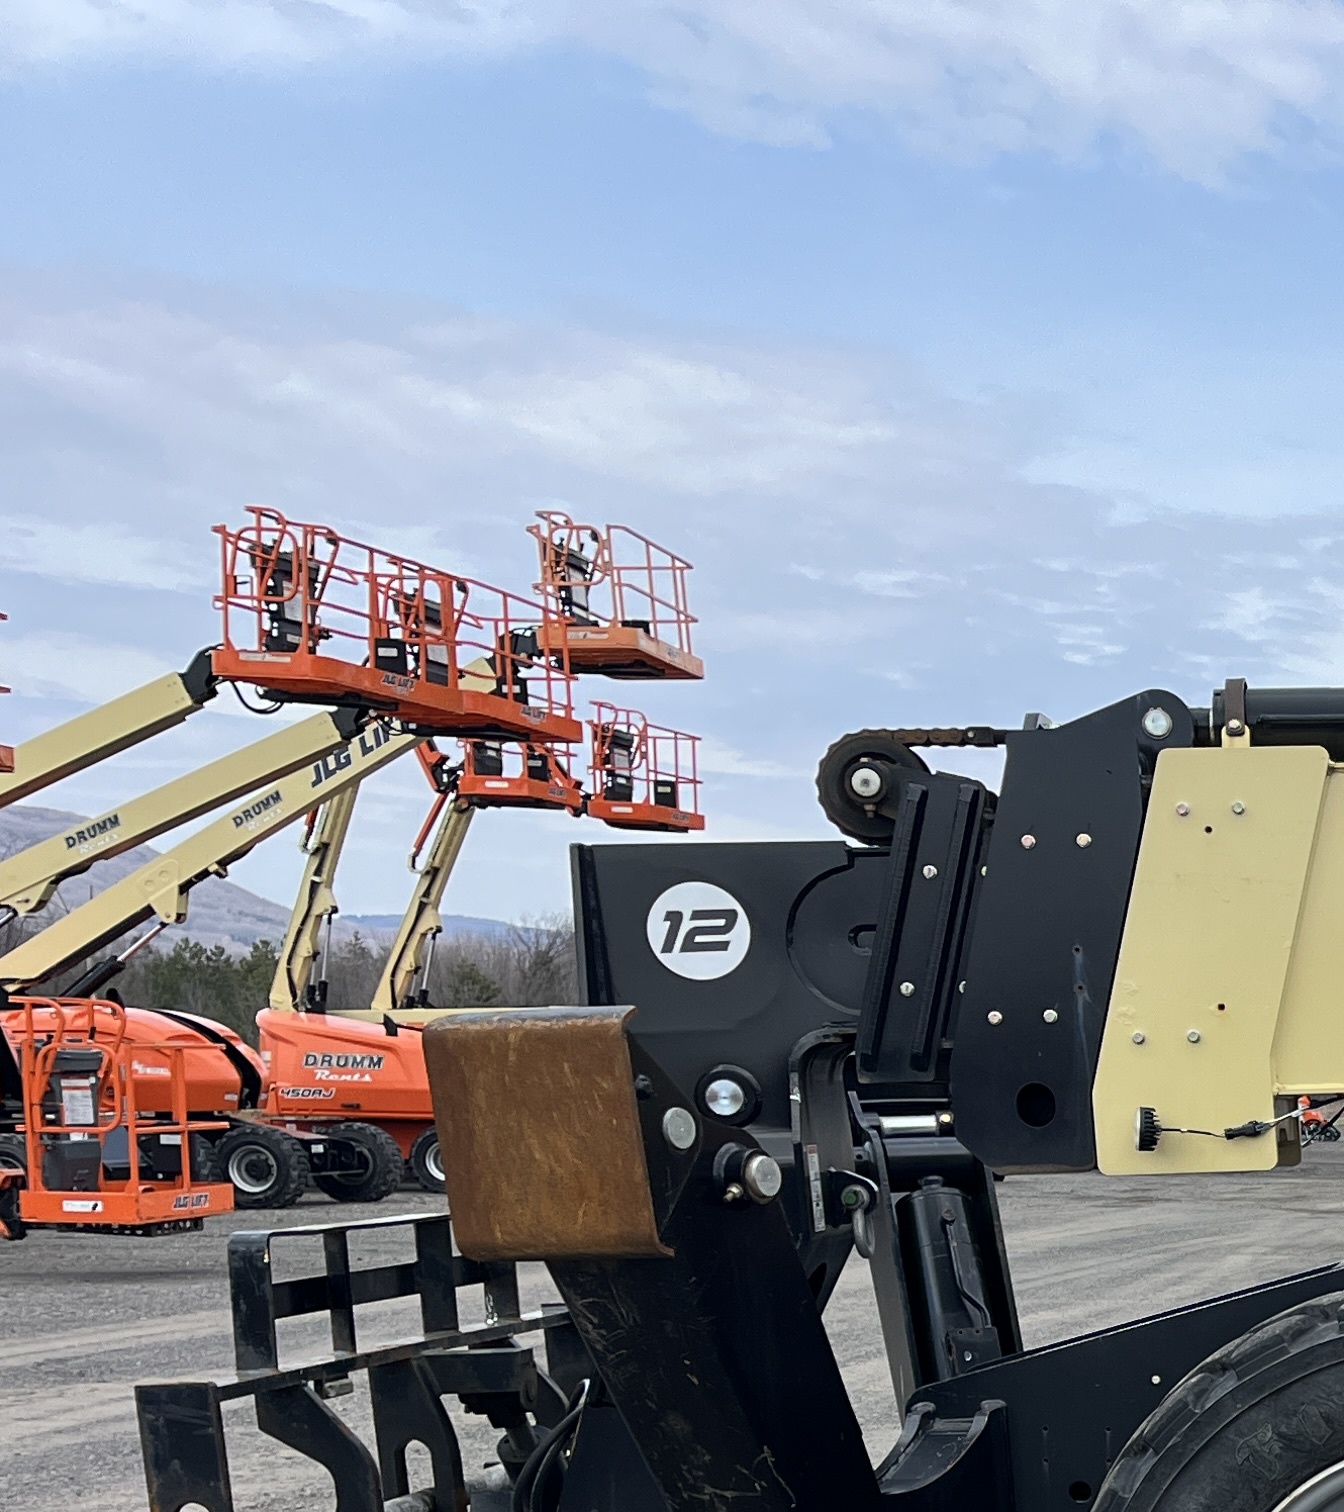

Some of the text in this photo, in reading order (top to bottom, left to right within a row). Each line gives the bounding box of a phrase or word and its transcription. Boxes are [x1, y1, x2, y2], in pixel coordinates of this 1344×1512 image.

[311, 746, 351, 788] JLG
[232, 790, 283, 829] DRUMM
[65, 814, 121, 849] DRUMM
[659, 908, 739, 954] 12
[305, 1053, 384, 1069] DRUMM
[314, 1069, 372, 1082] Rents
[280, 1088, 334, 1098] 450AJ
[174, 1194, 208, 1208] JLG LIFT
